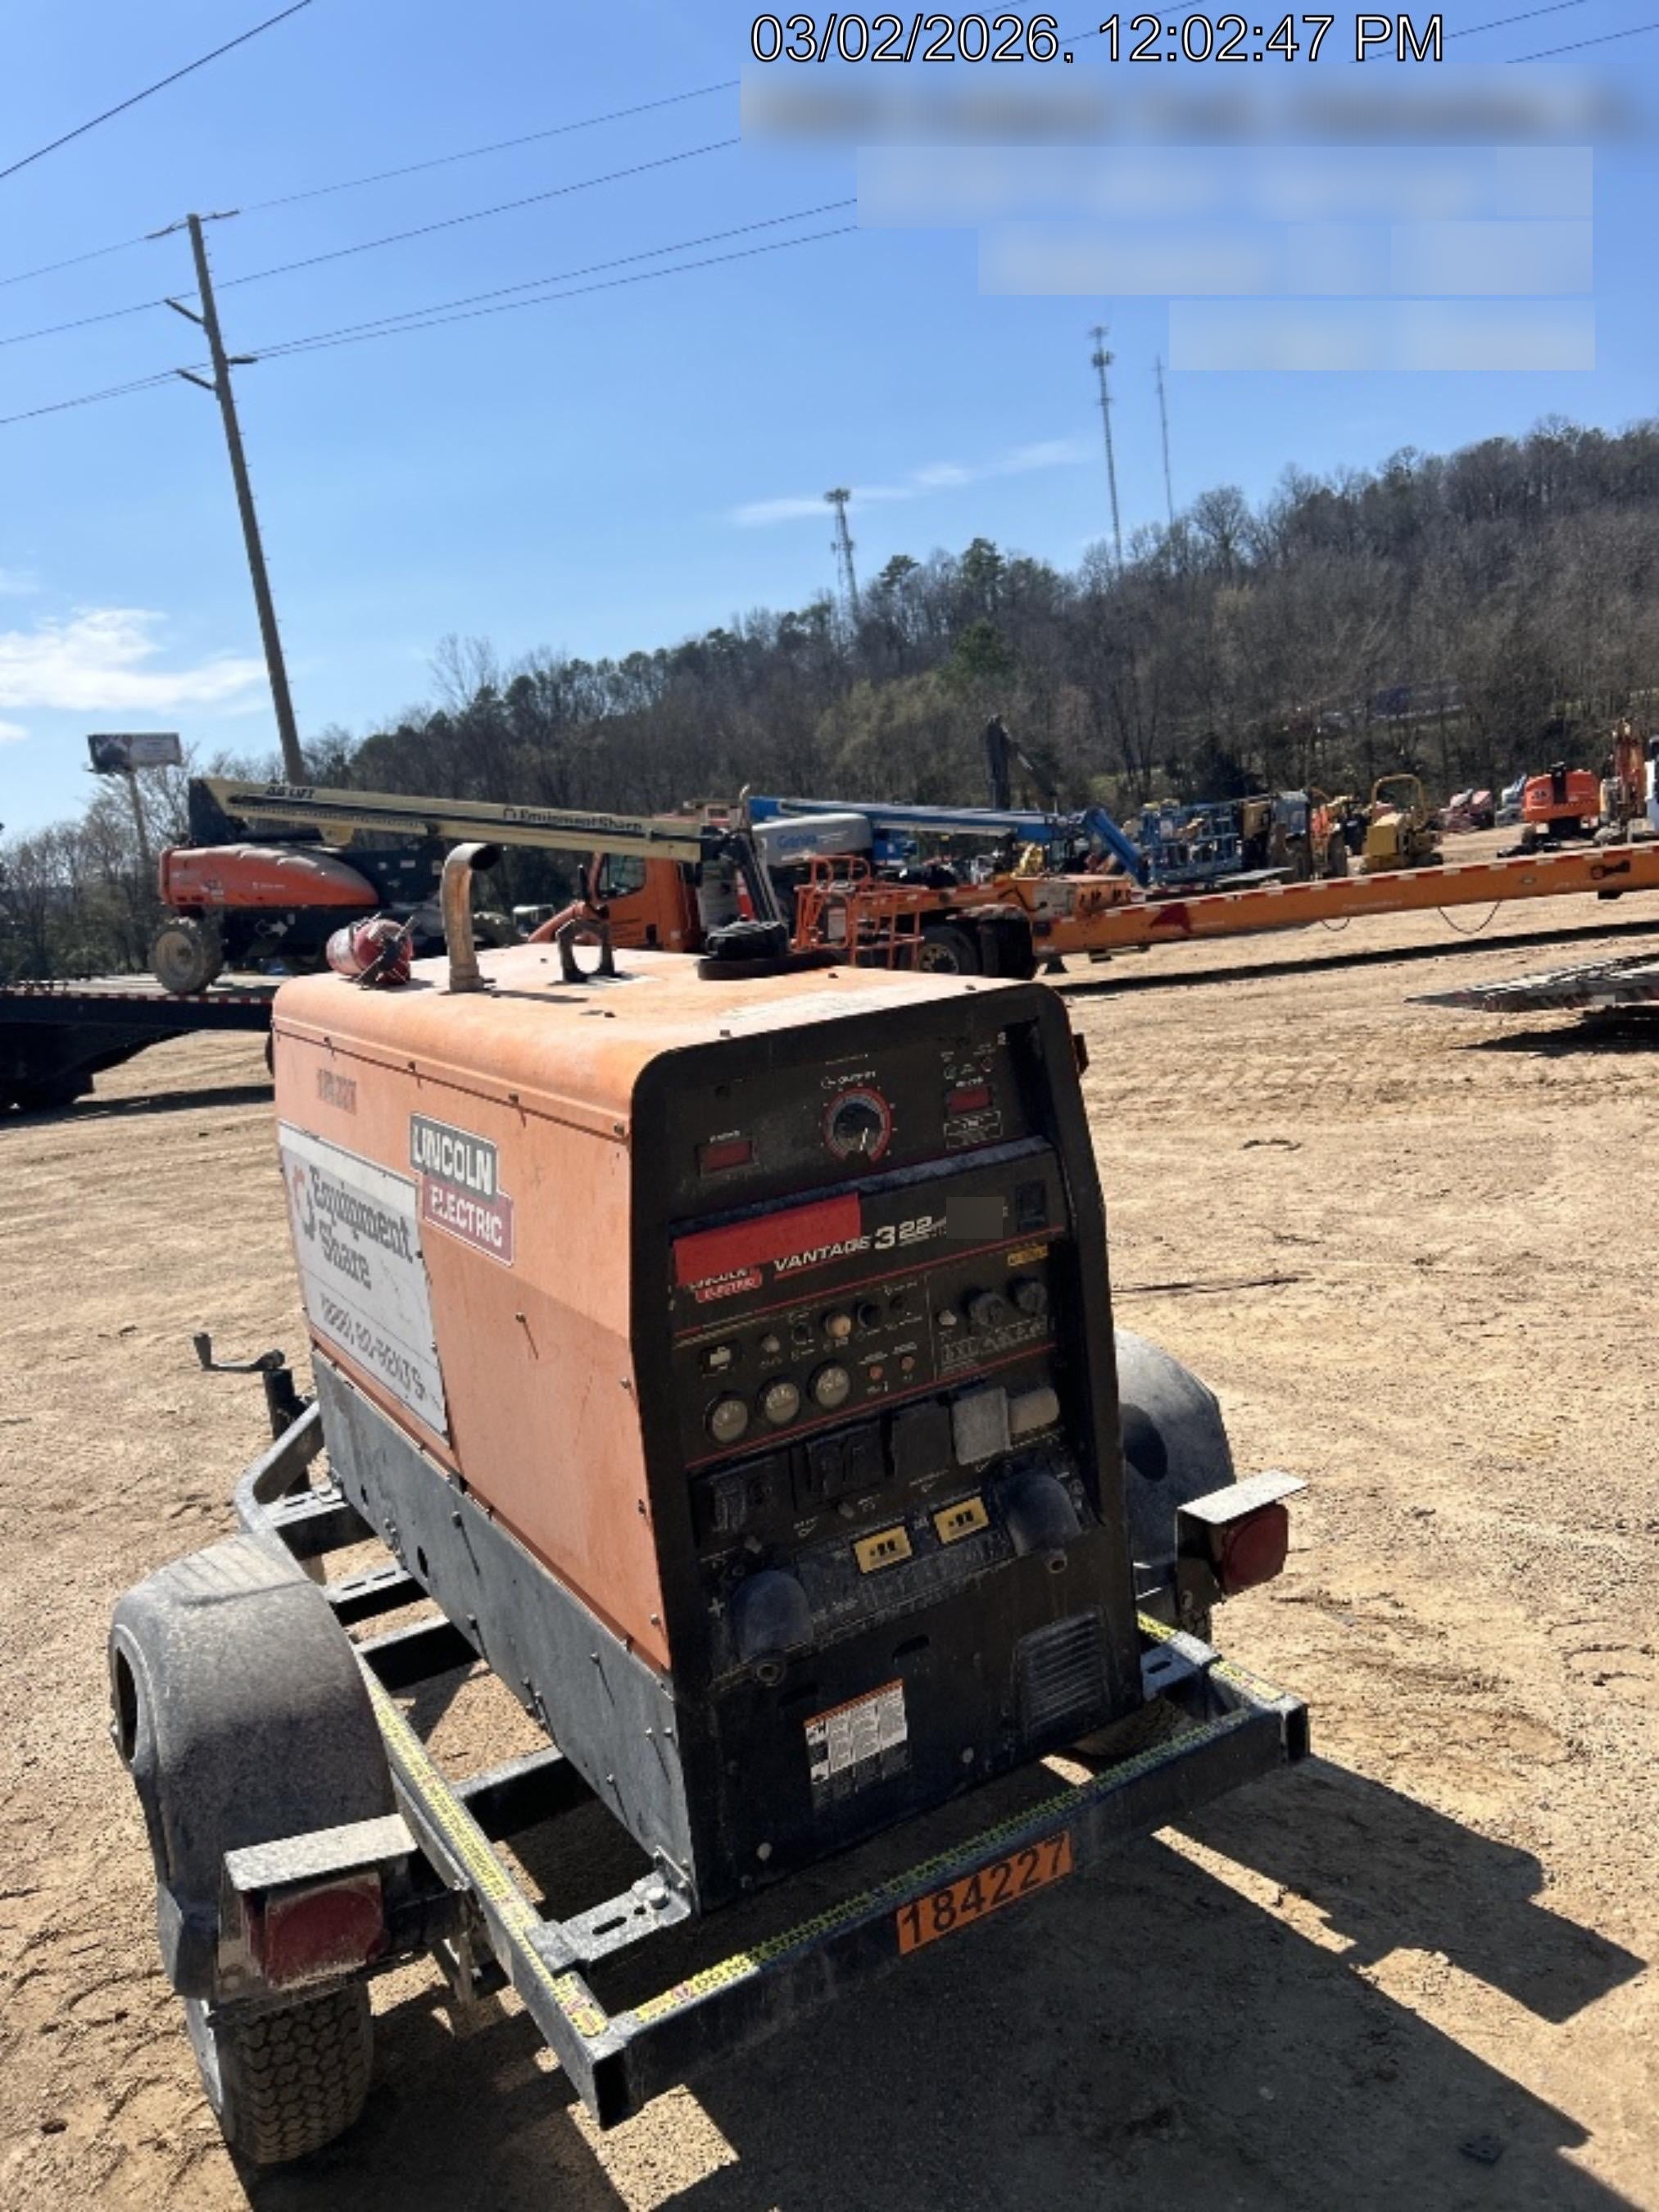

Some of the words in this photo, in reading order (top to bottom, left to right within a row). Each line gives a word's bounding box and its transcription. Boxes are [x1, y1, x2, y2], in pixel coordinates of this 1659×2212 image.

[412, 1123, 492, 1196] LINCOLN
[430, 1184, 502, 1248] ELECTRIC
[773, 1235, 872, 1272] VANTAGE
[874, 1215, 933, 1250] 322
[902, 1833, 1065, 1943] 184227
